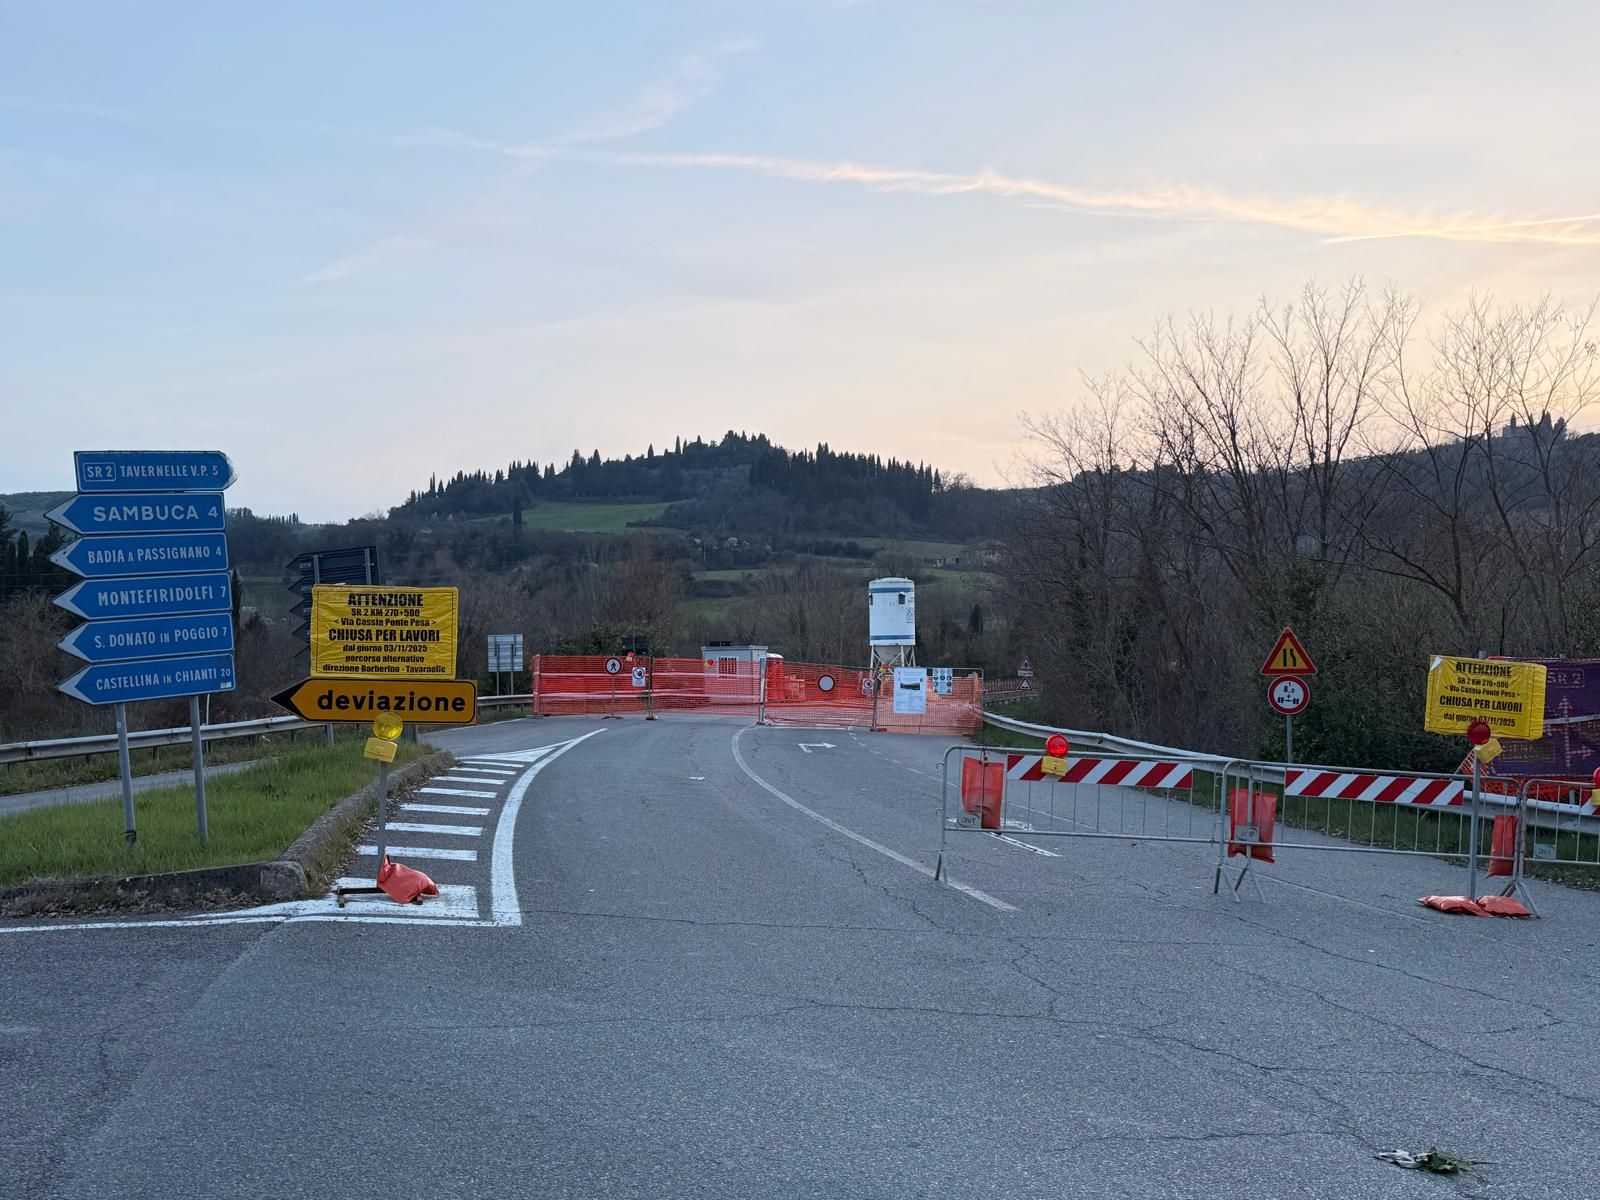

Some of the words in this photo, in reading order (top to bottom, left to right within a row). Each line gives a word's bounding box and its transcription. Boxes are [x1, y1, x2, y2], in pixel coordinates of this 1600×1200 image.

[87, 466, 103, 478] SR
[105, 466, 112, 478] 2
[120, 465, 188, 477] TAVERNELLE
[191, 465, 208, 477] V.P.
[212, 465, 219, 476] 5
[93, 505, 199, 522] SAMBUCA
[207, 506, 218, 518] 4
[87, 549, 125, 564] BADIA
[137, 546, 210, 562] PASSIGNANO
[215, 546, 222, 556] 4
[98, 585, 213, 607] MONTEFIRIDOLFI
[220, 585, 227, 598] 7
[347, 592, 424, 607] ATTENZIONE
[351, 608, 362, 617] SR
[363, 608, 369, 617] 2
[370, 608, 383, 617] KM
[341, 617, 355, 626] Via
[356, 617, 384, 627] Cassia
[385, 618, 409, 627] Ponte
[410, 618, 430, 627] Pesa
[94, 635, 106, 649] S.
[109, 631, 156, 647] DONATO
[174, 626, 218, 642] POGGIO
[222, 626, 228, 637] 7
[328, 628, 373, 642] CHIUSA
[375, 629, 397, 642] PER
[399, 629, 440, 642] LAVORI
[342, 644, 355, 652] dal
[356, 645, 382, 653] giorno
[383, 644, 428, 653] 03/11/2025
[345, 655, 381, 663] percorso
[382, 655, 425, 663] alternativo
[322, 663, 360, 672] direzione
[361, 664, 400, 673] Barberino
[1455, 661, 1512, 677] ATTENZIONE
[96, 674, 160, 690] CASTELLINA
[175, 667, 217, 682] CHIANTI
[220, 668, 231, 677] 20
[1466, 677, 1471, 685] 2
[1572, 672, 1581, 684] 2
[1449, 685, 1460, 693] Via
[1460, 685, 1481, 695] Cassia
[1482, 688, 1500, 696] Ponte
[1500, 690, 1516, 698] Pesa
[317, 690, 466, 713] deviazione
[1439, 695, 1473, 708] CHIUSA
[1474, 698, 1491, 710] PER
[1491, 700, 1523, 713] LAVORI
[1443, 712, 1455, 721] dal
